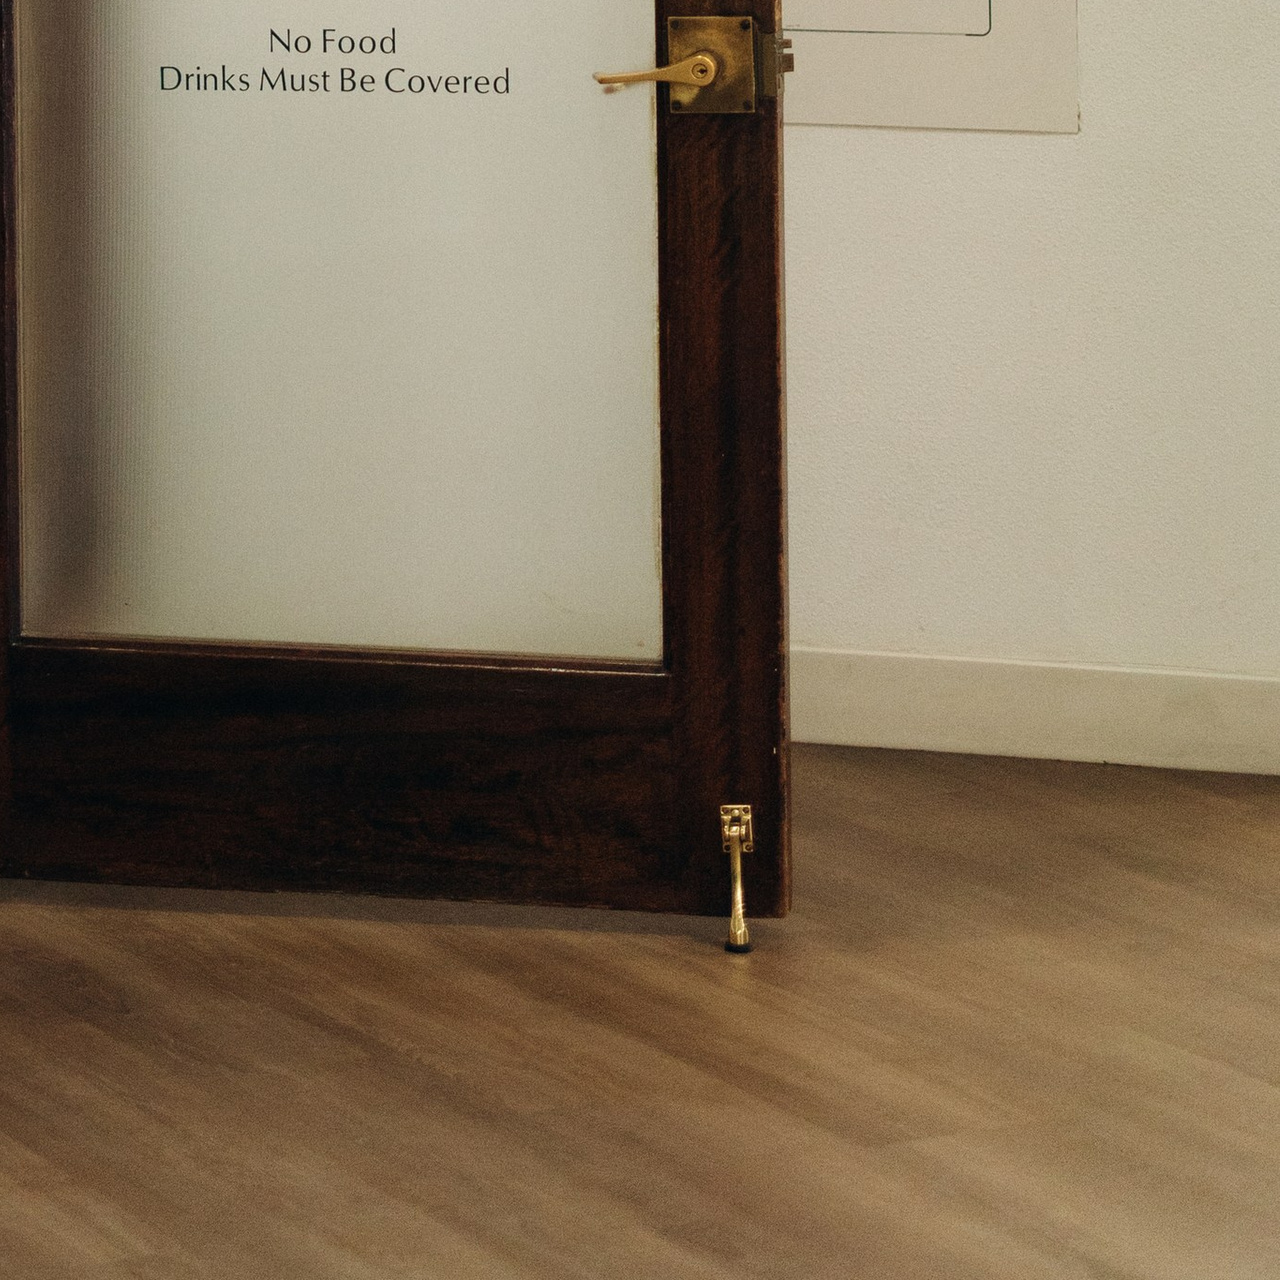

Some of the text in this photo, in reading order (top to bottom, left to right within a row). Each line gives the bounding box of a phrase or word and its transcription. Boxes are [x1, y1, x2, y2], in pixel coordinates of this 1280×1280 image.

[269, 26, 397, 55] No Food
[159, 64, 510, 95] Drinks Must Be Covered
